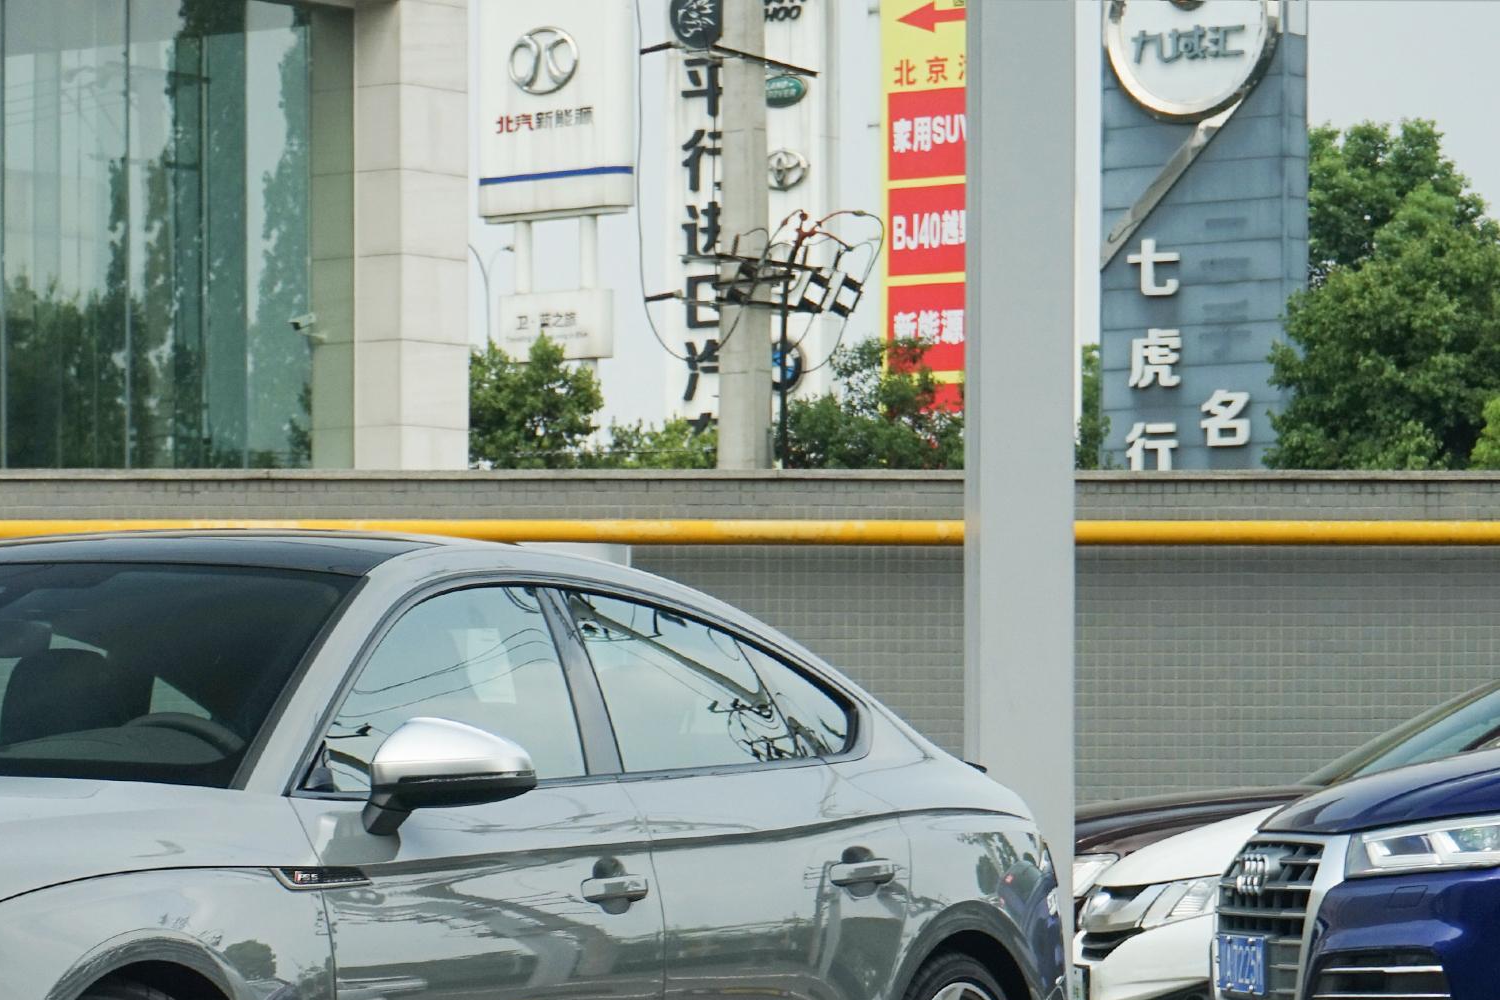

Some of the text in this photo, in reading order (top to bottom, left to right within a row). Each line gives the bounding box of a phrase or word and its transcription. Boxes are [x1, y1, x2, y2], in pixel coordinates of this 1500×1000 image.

[496, 106, 593, 134] 北汽新能源
[1200, 389, 1251, 447] 名
